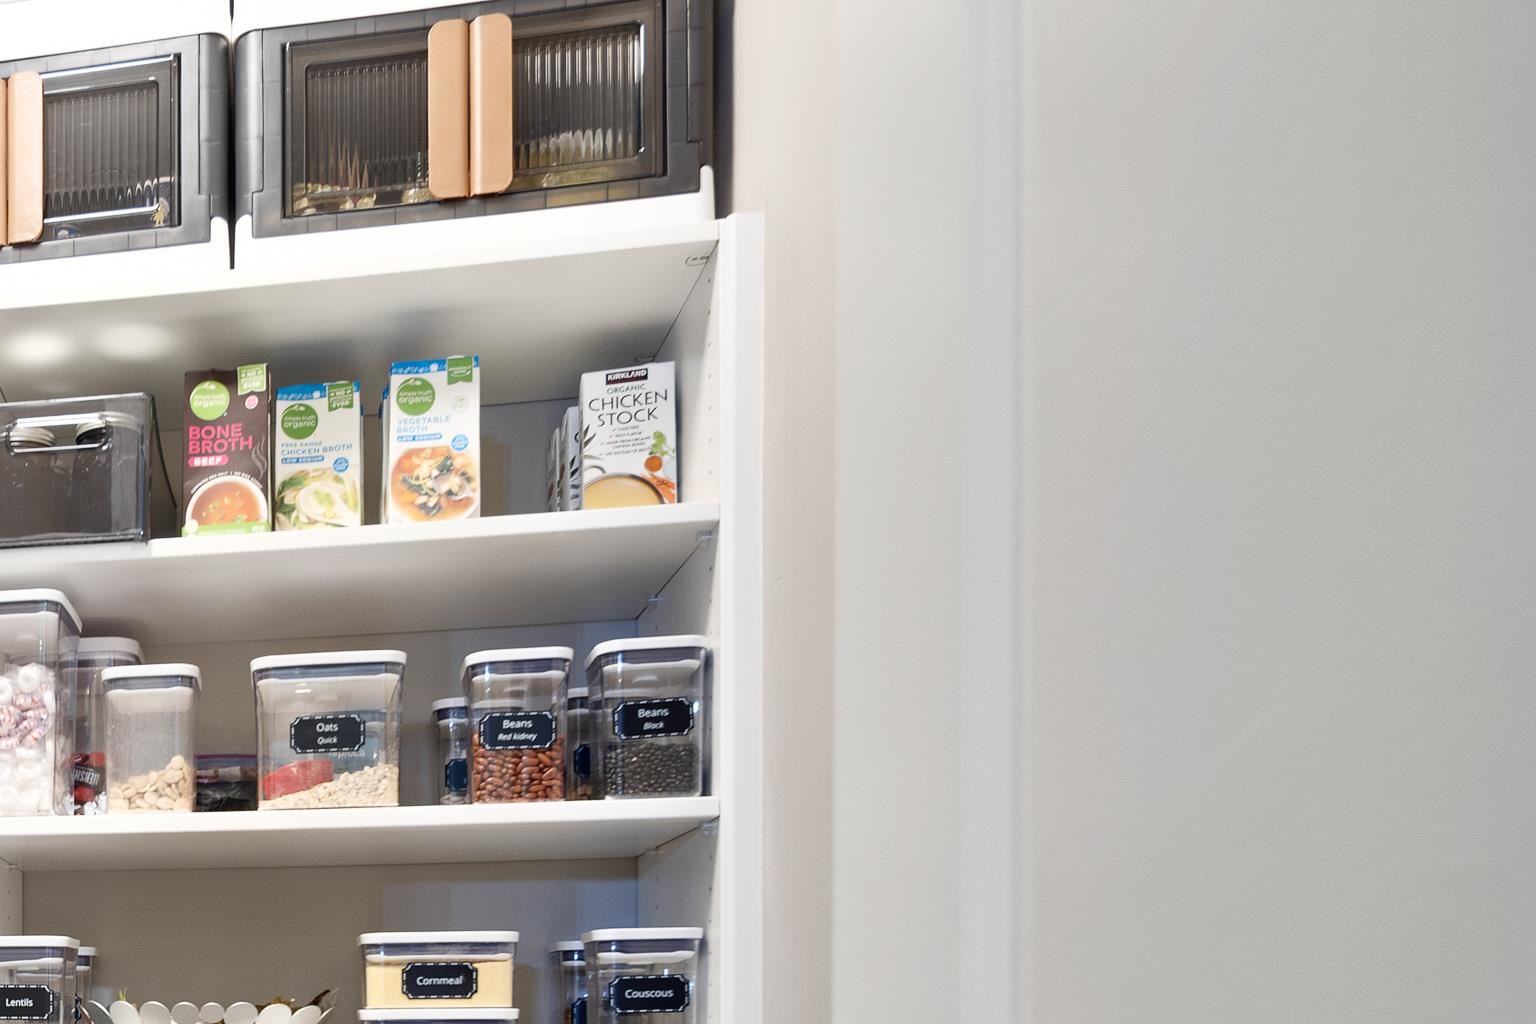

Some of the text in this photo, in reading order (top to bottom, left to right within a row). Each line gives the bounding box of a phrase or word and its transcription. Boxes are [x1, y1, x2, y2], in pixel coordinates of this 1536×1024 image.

[607, 370, 647, 381] KIRKLAND
[607, 384, 646, 394] ORGANIC
[588, 388, 668, 412] CHICKEN
[398, 416, 450, 425] VEGETABLE
[598, 407, 659, 427] STOCK
[284, 419, 316, 429] organic
[189, 423, 242, 440] BONE
[188, 435, 253, 455] BROTH
[281, 443, 353, 456] CHICKEN BROTH
[637, 708, 670, 718] Beans
[316, 723, 339, 732] Oats
[502, 719, 533, 729] Beans
[643, 721, 664, 730] Black
[317, 736, 337, 745] Quick
[497, 733, 537, 742] Red kidney
[416, 975, 463, 986] Cornmeal
[624, 989, 674, 999] Couscous
[5, 998, 34, 1007] Lentils
